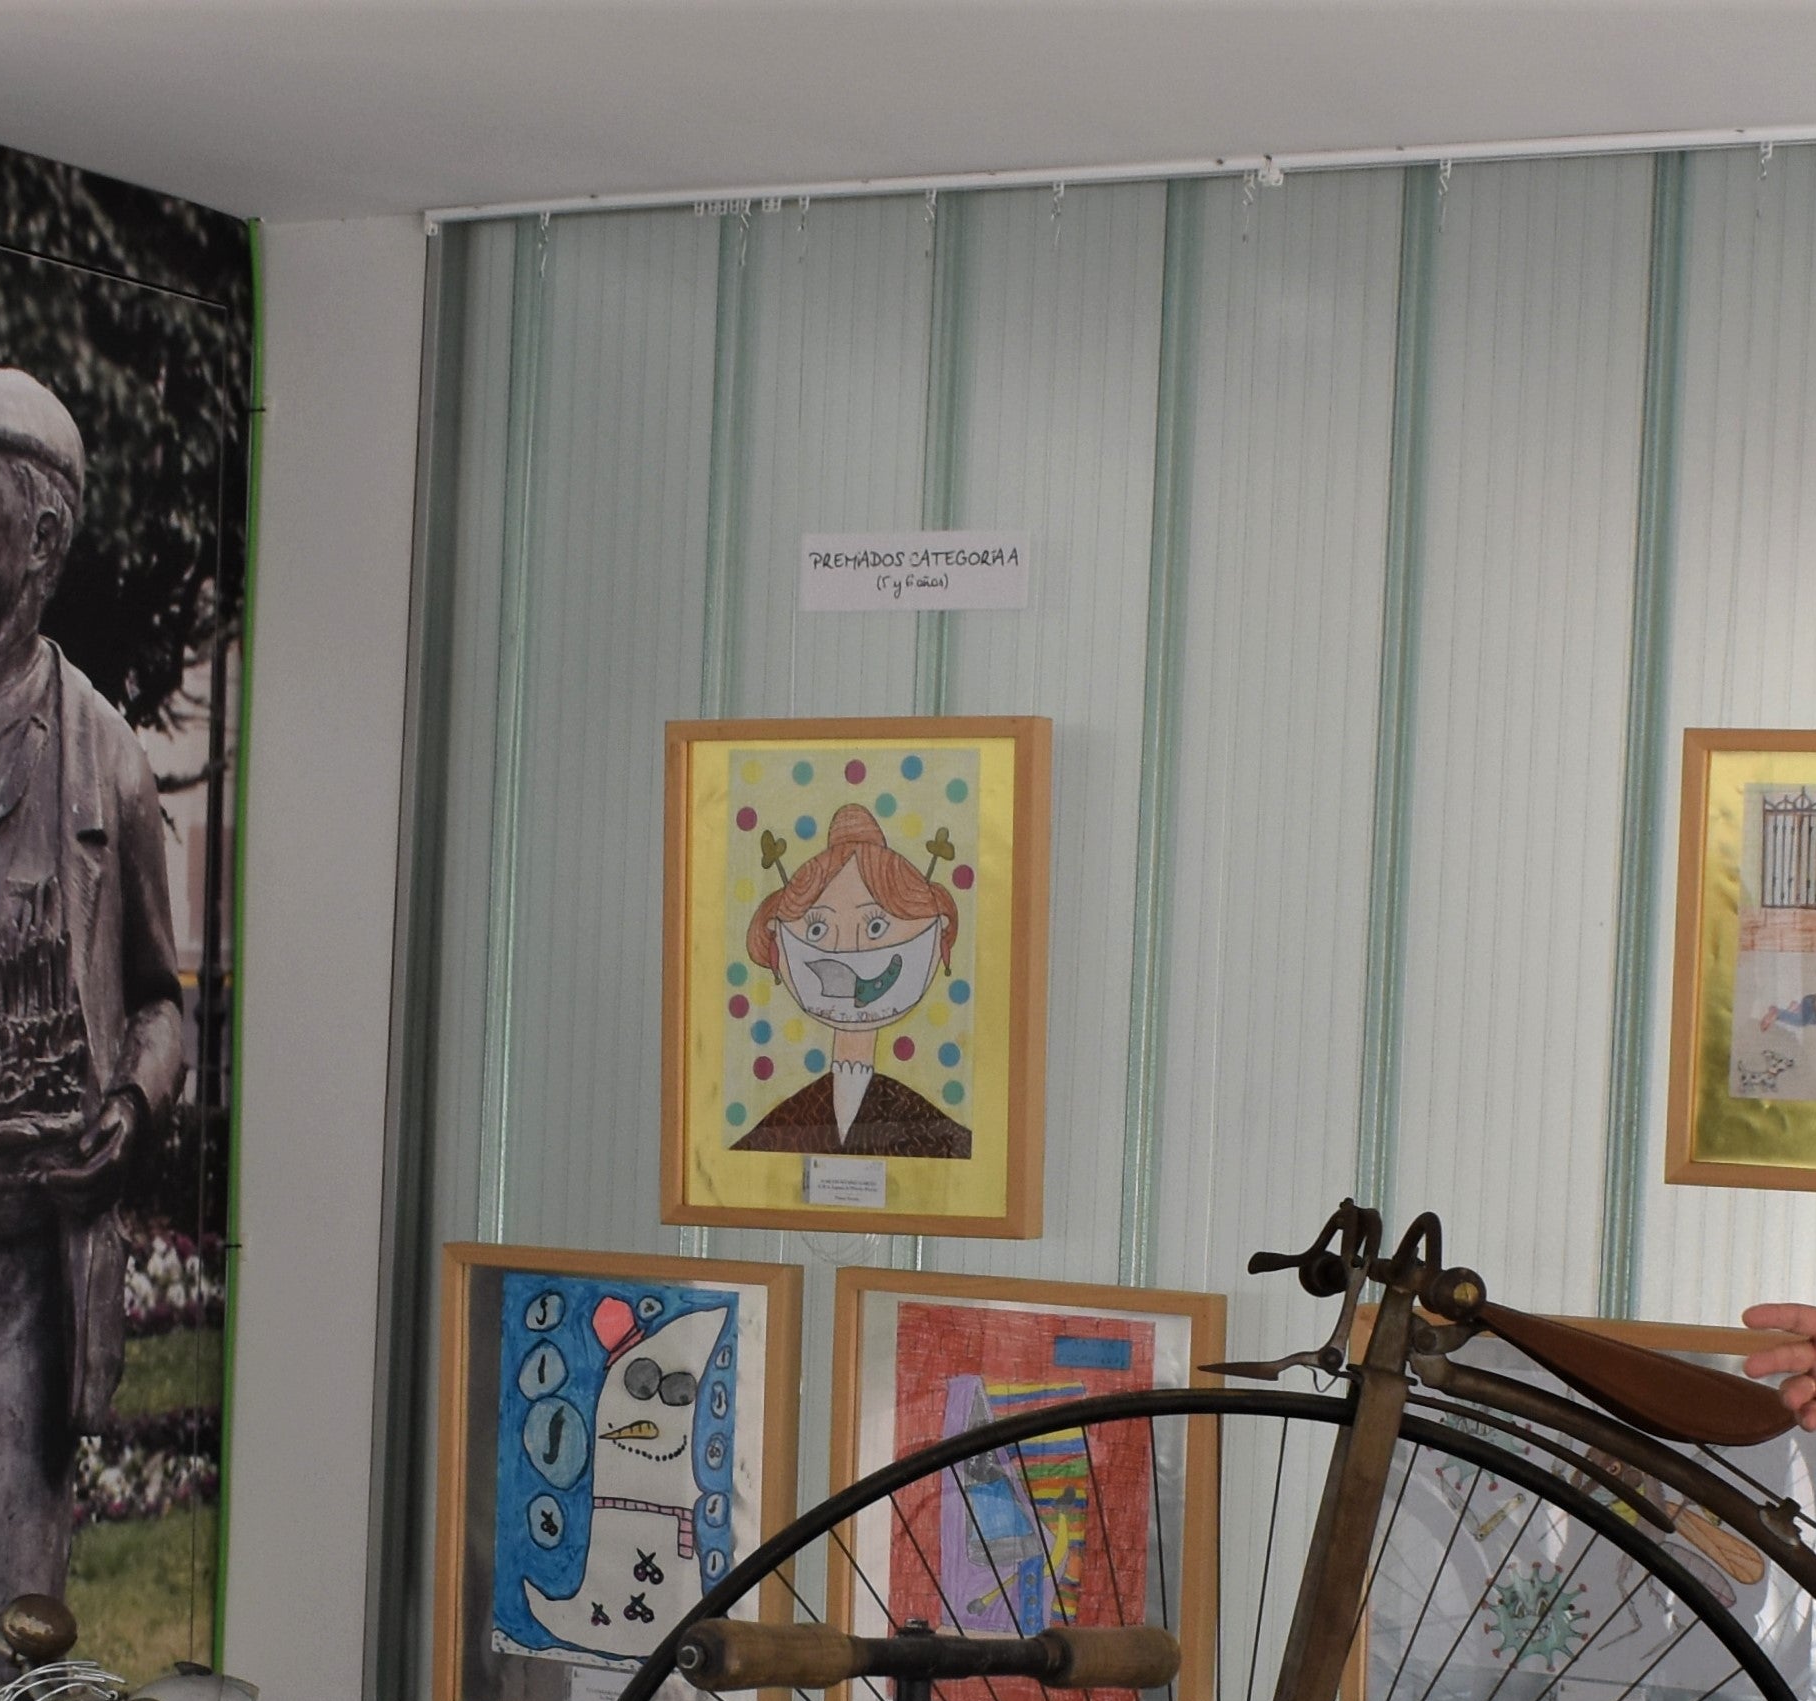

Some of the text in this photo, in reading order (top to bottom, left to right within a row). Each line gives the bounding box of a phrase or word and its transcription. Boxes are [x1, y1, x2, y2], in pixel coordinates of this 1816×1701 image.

[809, 550, 905, 570] PREMIADOS
[1006, 547, 1019, 566] A
[893, 581, 902, 599] y
